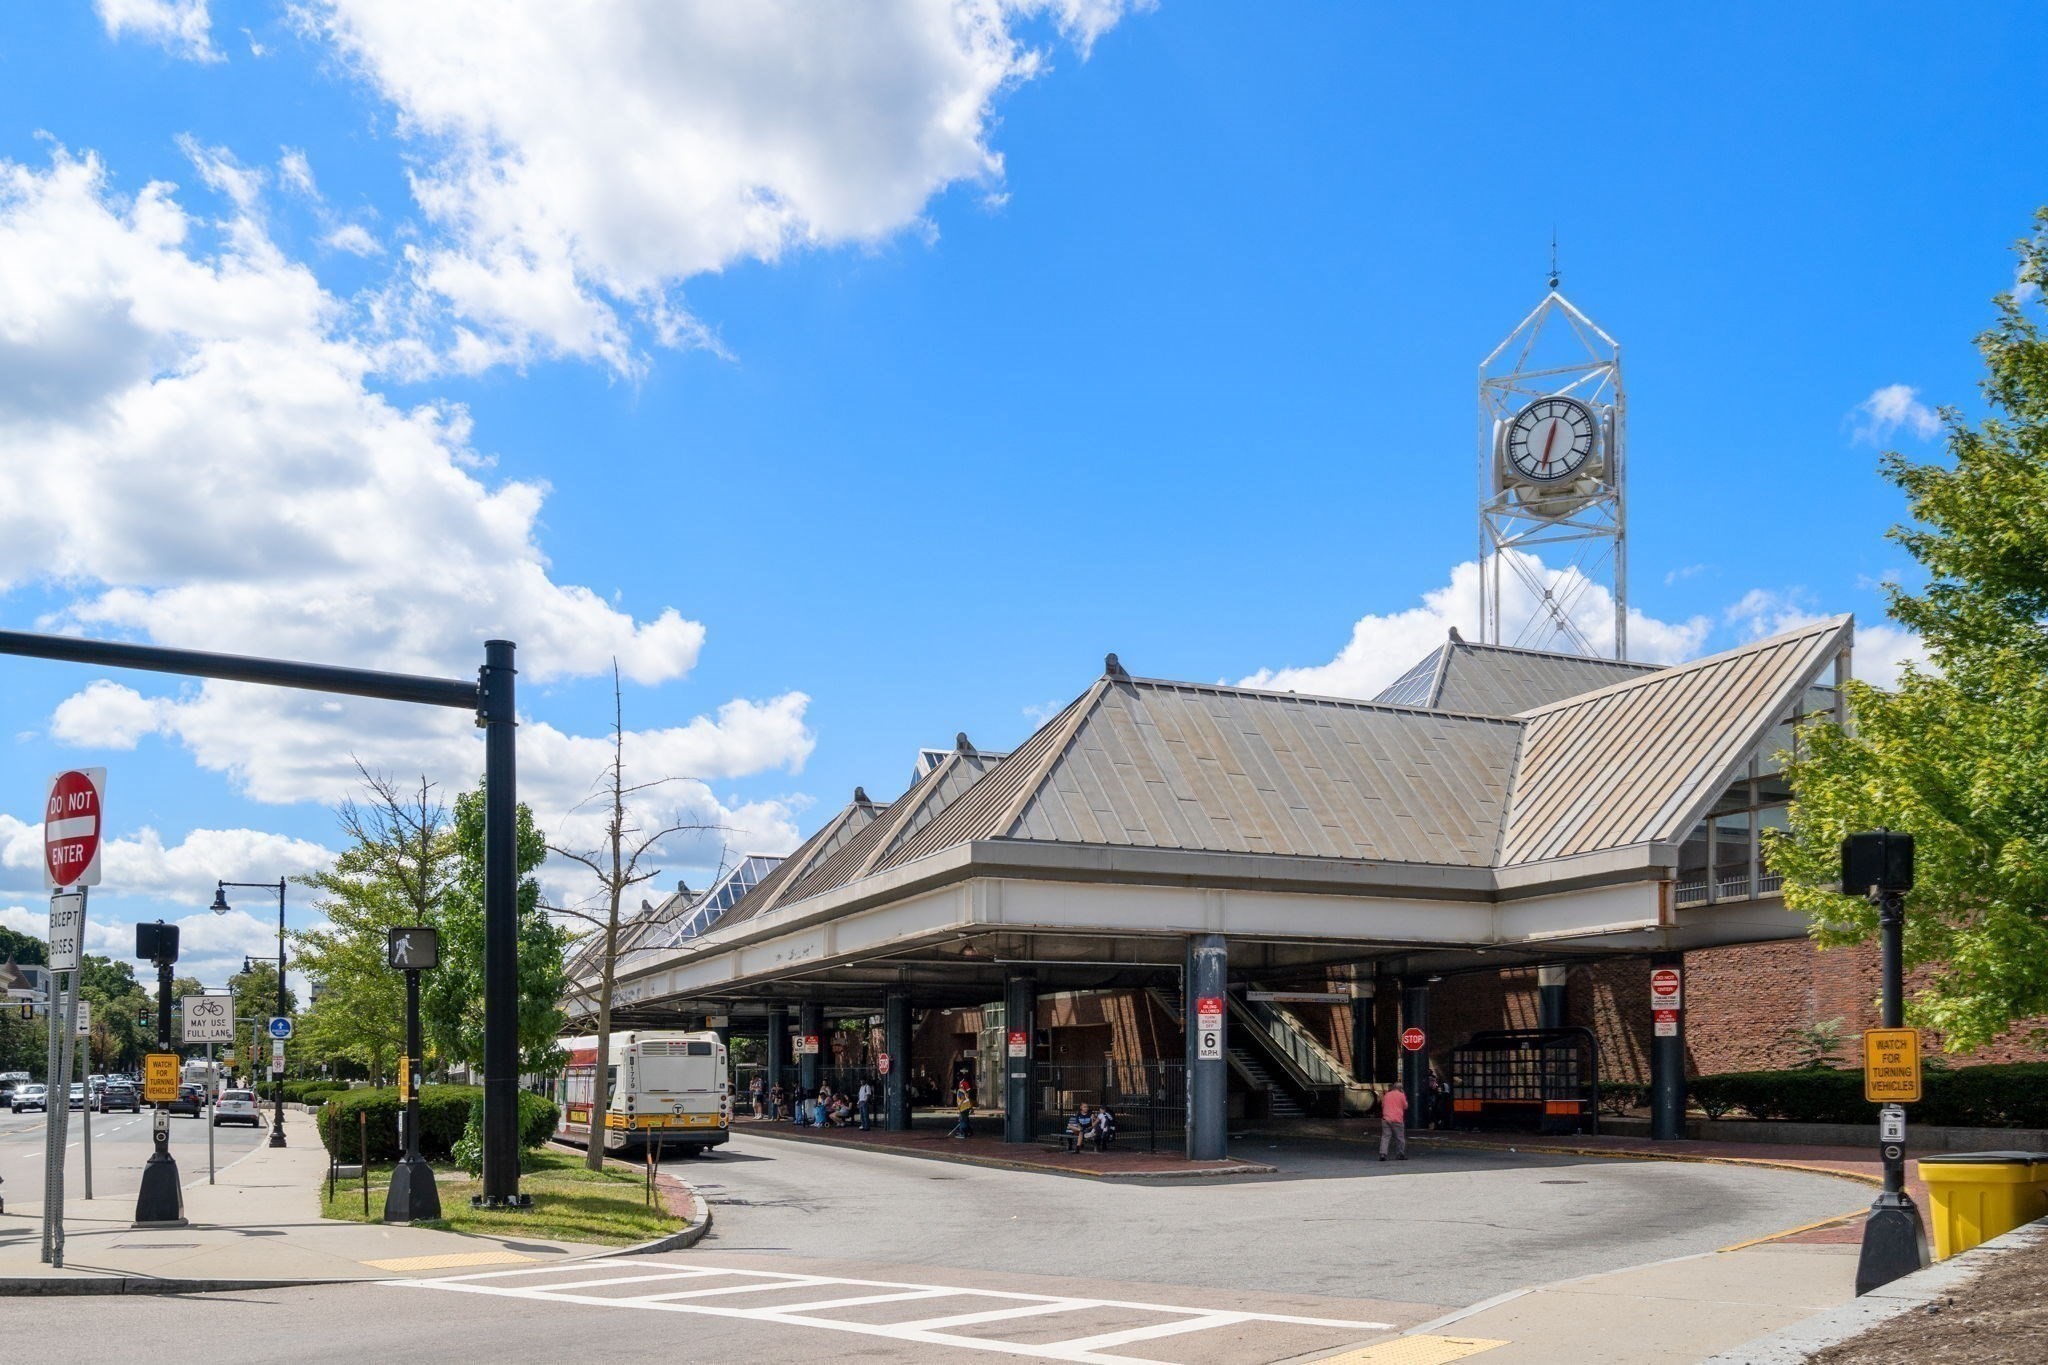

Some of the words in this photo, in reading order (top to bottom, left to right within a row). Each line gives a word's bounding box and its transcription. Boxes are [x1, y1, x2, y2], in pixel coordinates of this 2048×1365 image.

[50, 795, 63, 815] DO
[68, 791, 93, 811] NOT
[52, 844, 84, 866] ENTER
[50, 910, 79, 928] EXCEPT
[51, 938, 74, 955] BUSES
[191, 1019, 207, 1027] MAY
[211, 1019, 226, 1027] USE
[187, 1029, 207, 1038] FULL
[211, 1029, 230, 1037] LANE
[796, 1038, 803, 1048] 6
[1204, 1032, 1216, 1048] 6
[1404, 1035, 1424, 1044] STOP
[1875, 1039, 1907, 1050] WATCH
[1882, 1053, 1901, 1064] FOR
[156, 1069, 168, 1077] FOR
[1872, 1067, 1912, 1078] TURNING
[149, 1078, 175, 1086] TURNING
[1871, 1080, 1914, 1091] VEHICLES
[148, 1087, 176, 1095] VEHICLES
